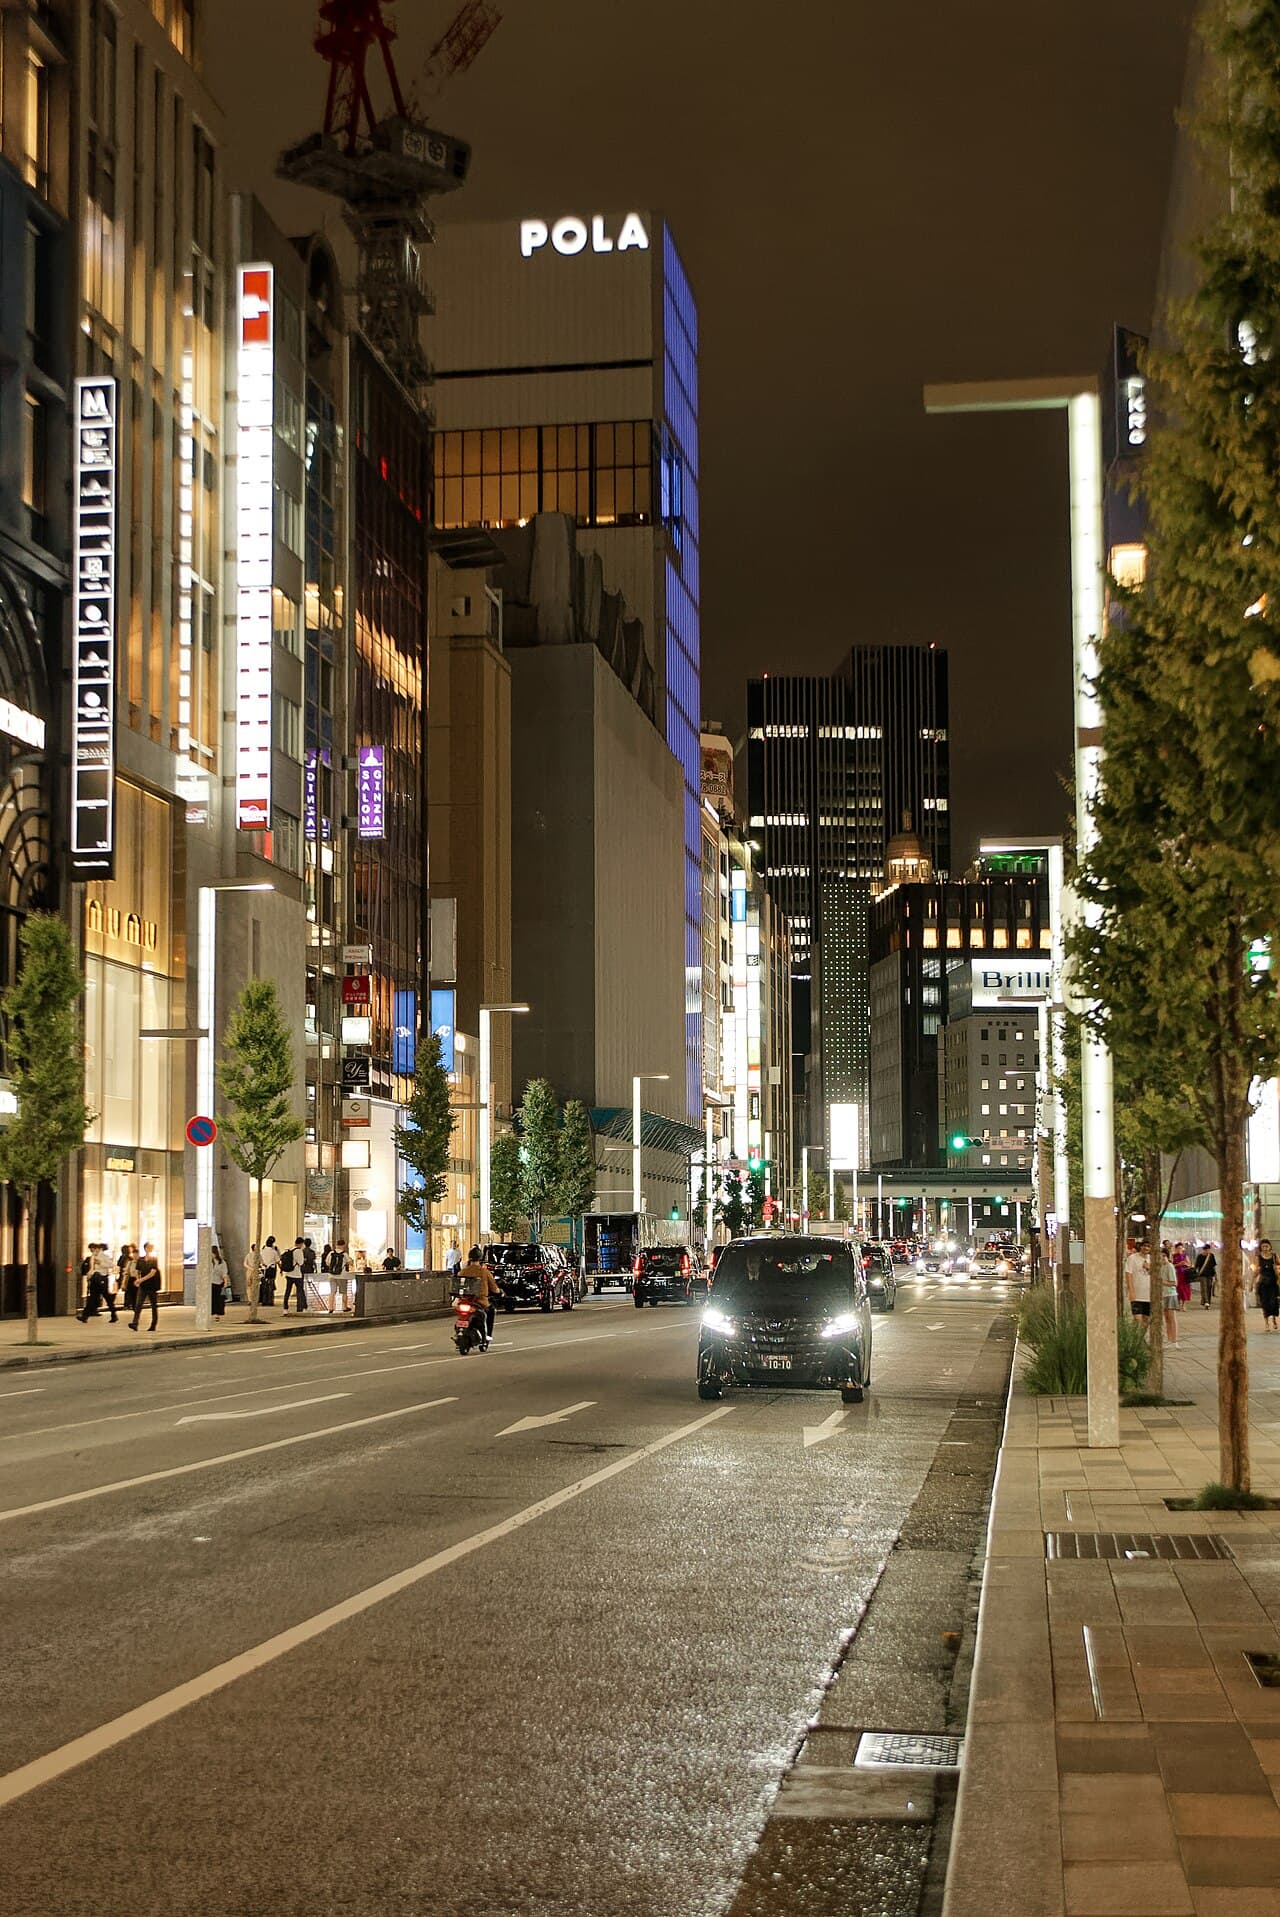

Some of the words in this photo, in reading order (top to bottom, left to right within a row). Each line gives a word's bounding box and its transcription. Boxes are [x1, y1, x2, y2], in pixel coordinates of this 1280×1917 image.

[520, 212, 649, 257] POLA
[361, 770, 371, 826] SALON
[373, 769, 382, 825] GINZA
